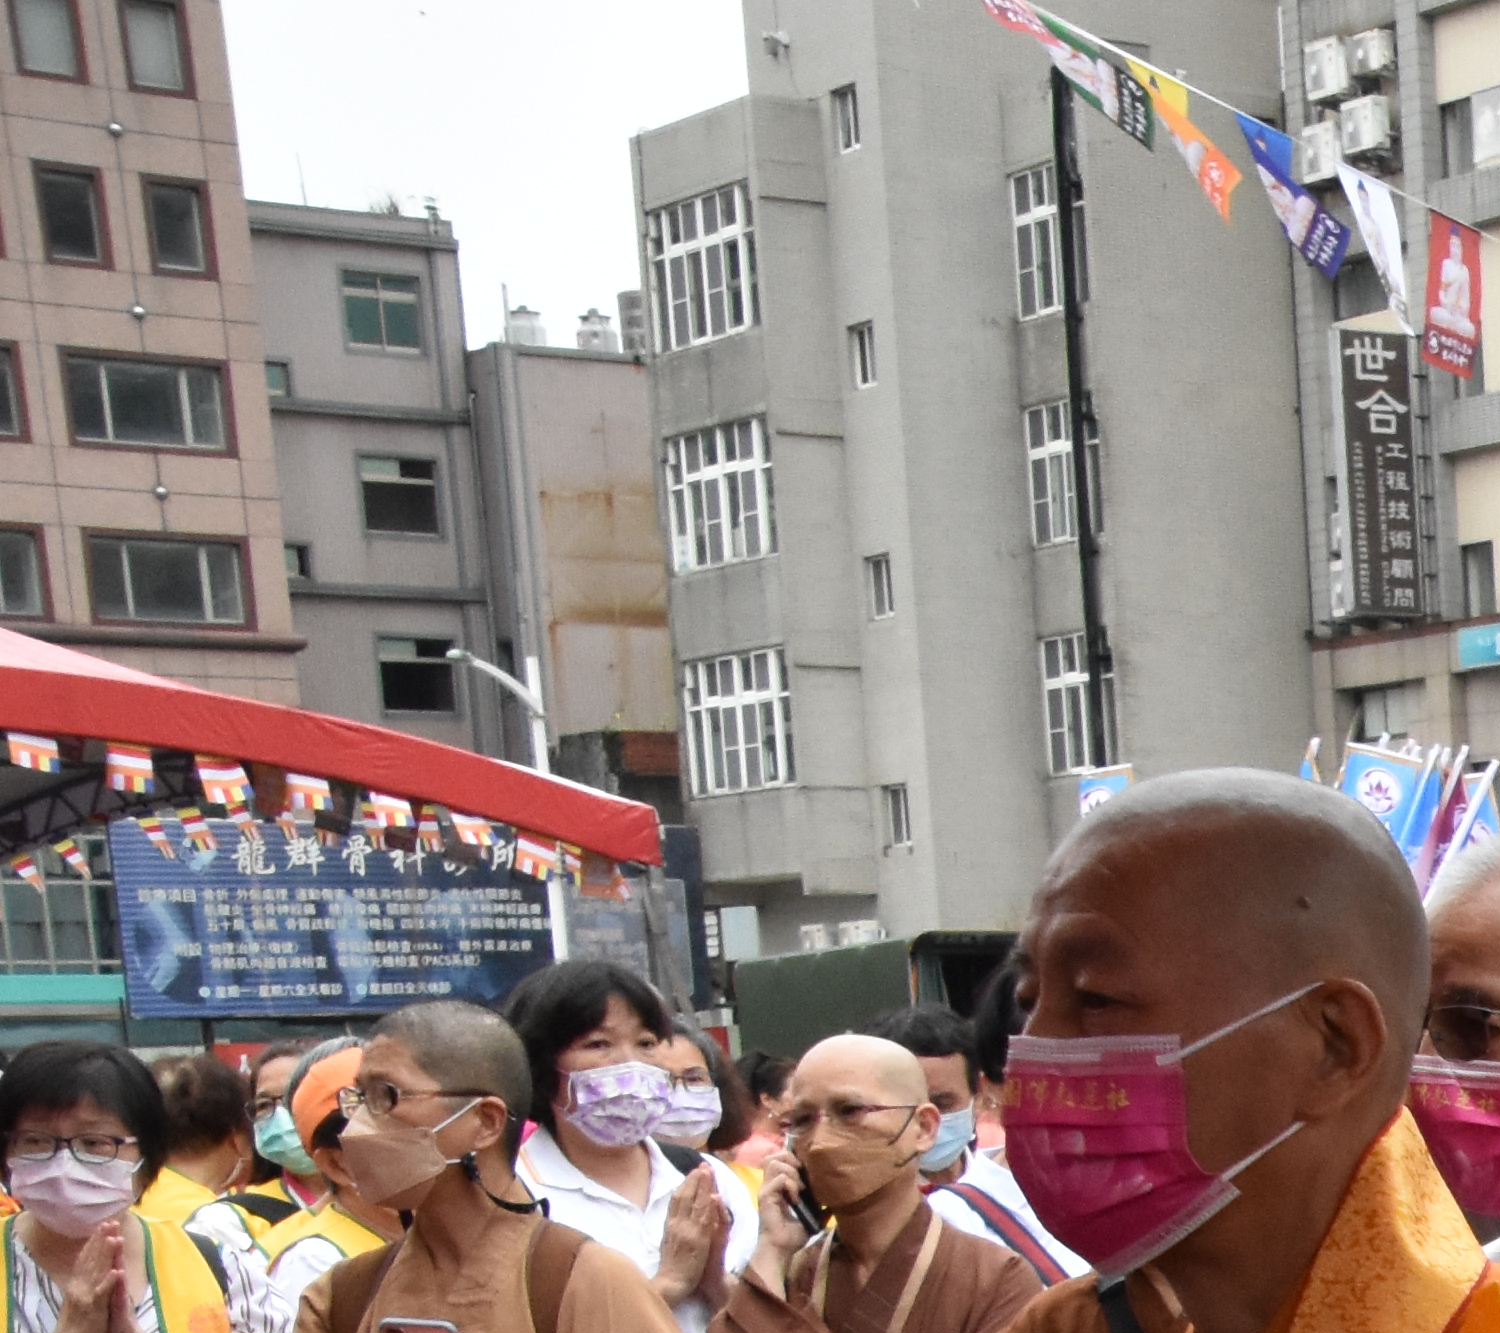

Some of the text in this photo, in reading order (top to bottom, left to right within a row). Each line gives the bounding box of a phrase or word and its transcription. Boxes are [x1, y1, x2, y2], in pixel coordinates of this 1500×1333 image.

[1344, 337, 1408, 435] 世合
[1385, 443, 1415, 608] 工程技術顧問
[231, 834, 517, 876] 龍群骨科所
